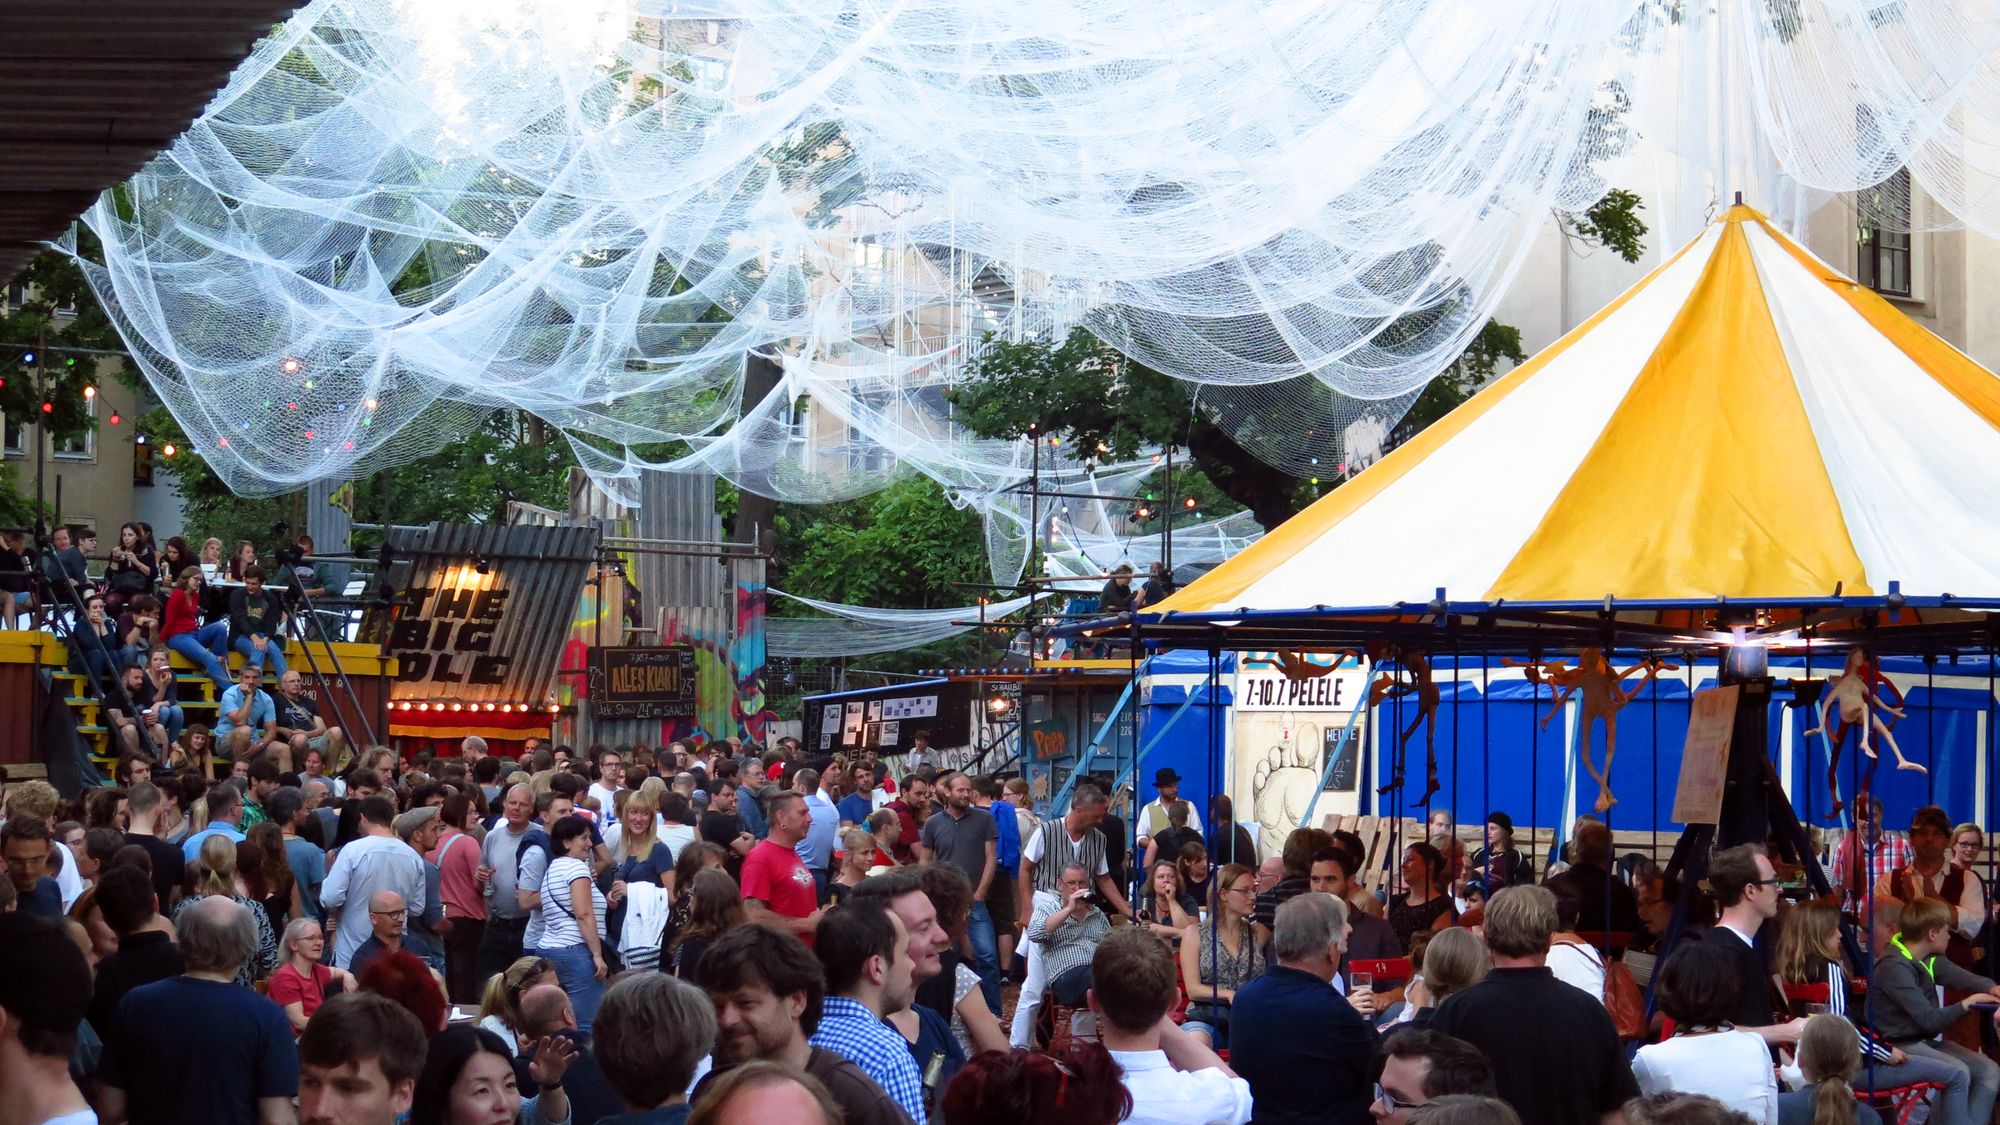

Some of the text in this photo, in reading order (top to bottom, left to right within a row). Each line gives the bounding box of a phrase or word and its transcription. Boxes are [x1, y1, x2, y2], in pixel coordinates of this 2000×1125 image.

[402, 588, 510, 619] THE
[392, 620, 496, 651] BIG
[612, 664, 645, 693] ALLES
[646, 665, 678, 692] KLAR!
[1288, 678, 1343, 706] PELELE
[1326, 728, 1357, 742] HEUE
[1375, 962, 1387, 973] 14
